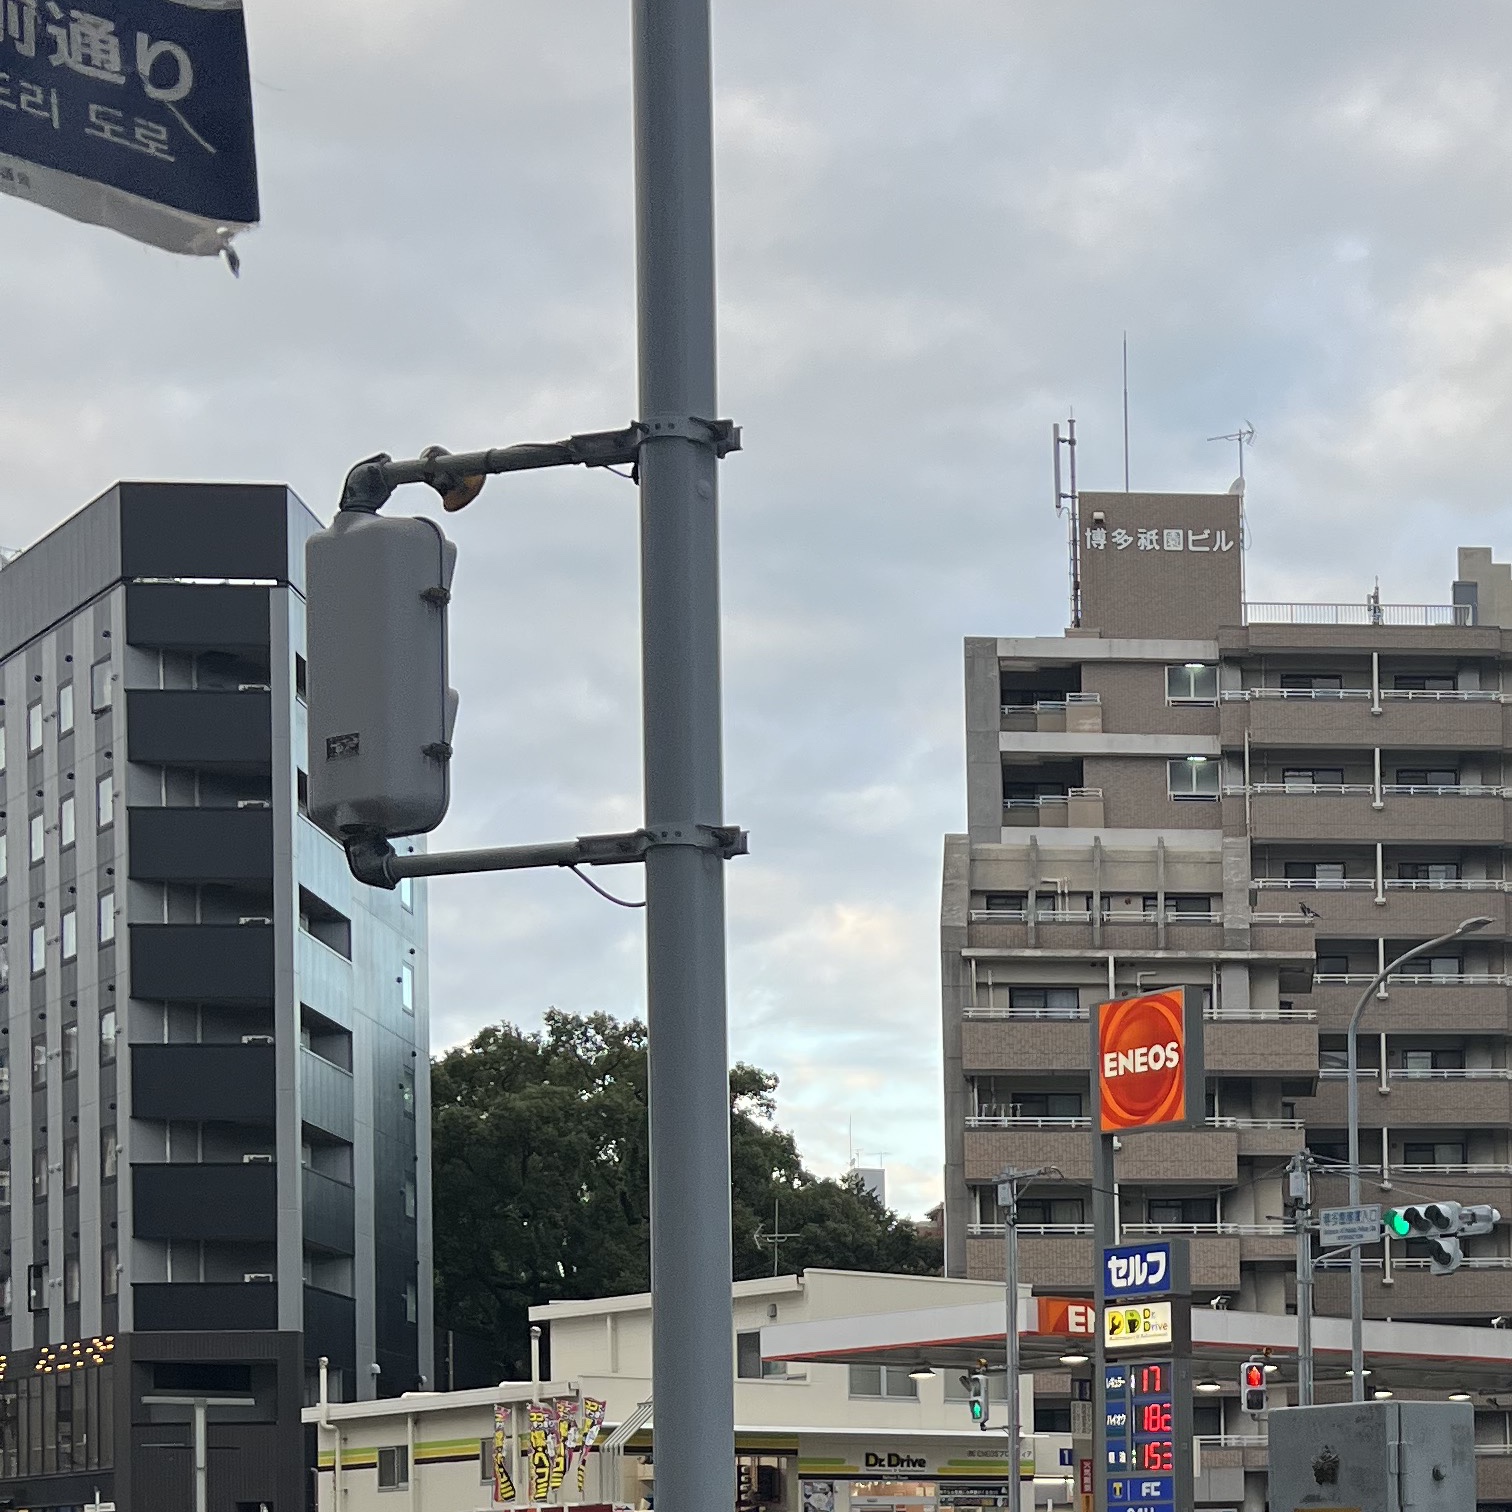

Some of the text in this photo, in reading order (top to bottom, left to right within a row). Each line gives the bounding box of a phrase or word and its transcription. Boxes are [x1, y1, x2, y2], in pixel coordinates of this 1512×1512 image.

[84, 103, 176, 162] 도로
[1085, 528, 1234, 552] 博多祇園ビル
[1104, 1041, 1180, 1078] ENEOS
[1108, 1251, 1166, 1288] セルフ
[1143, 1321, 1168, 1333] Drive
[1141, 1481, 1161, 1497] FC
